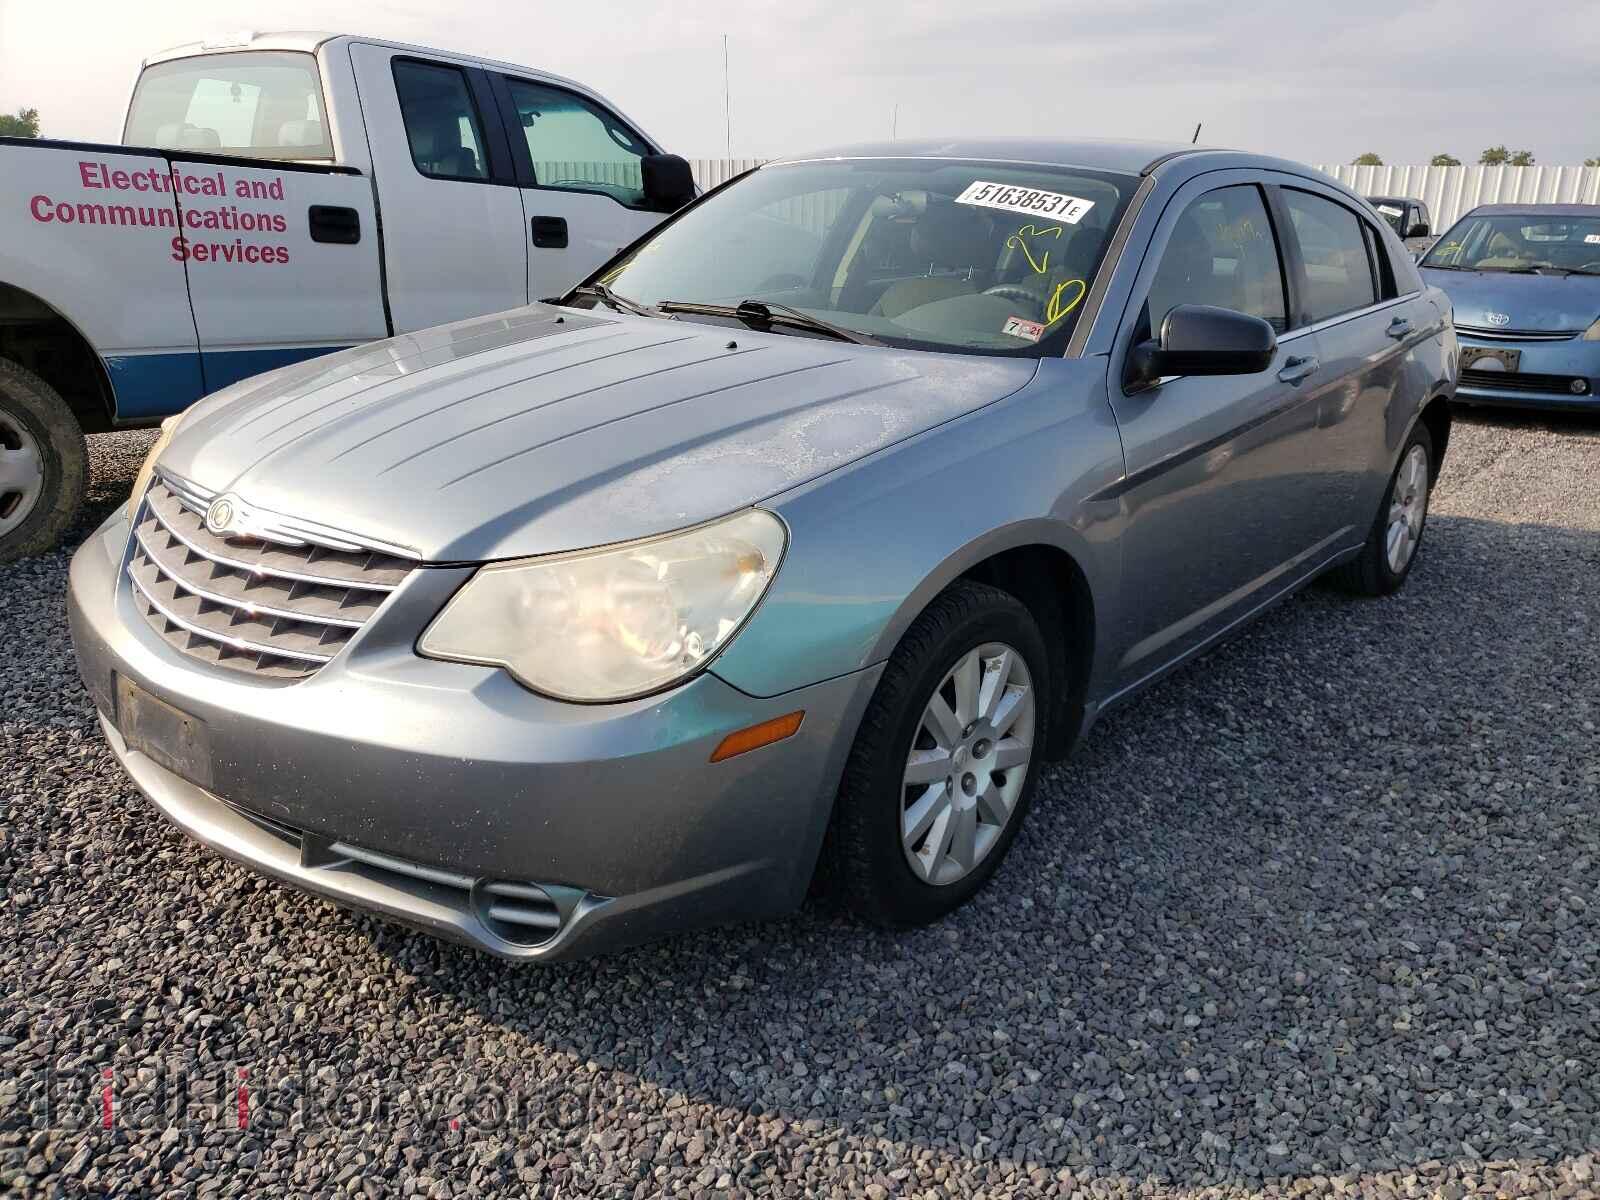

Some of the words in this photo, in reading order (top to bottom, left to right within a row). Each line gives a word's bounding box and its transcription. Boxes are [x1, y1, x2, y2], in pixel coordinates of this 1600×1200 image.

[78, 161, 226, 196] Electrical
[234, 178, 285, 201] and
[30, 195, 288, 233] Communications
[975, 184, 1074, 215] 51638531
[171, 236, 290, 264] Services
[1007, 321, 1020, 332] 7
